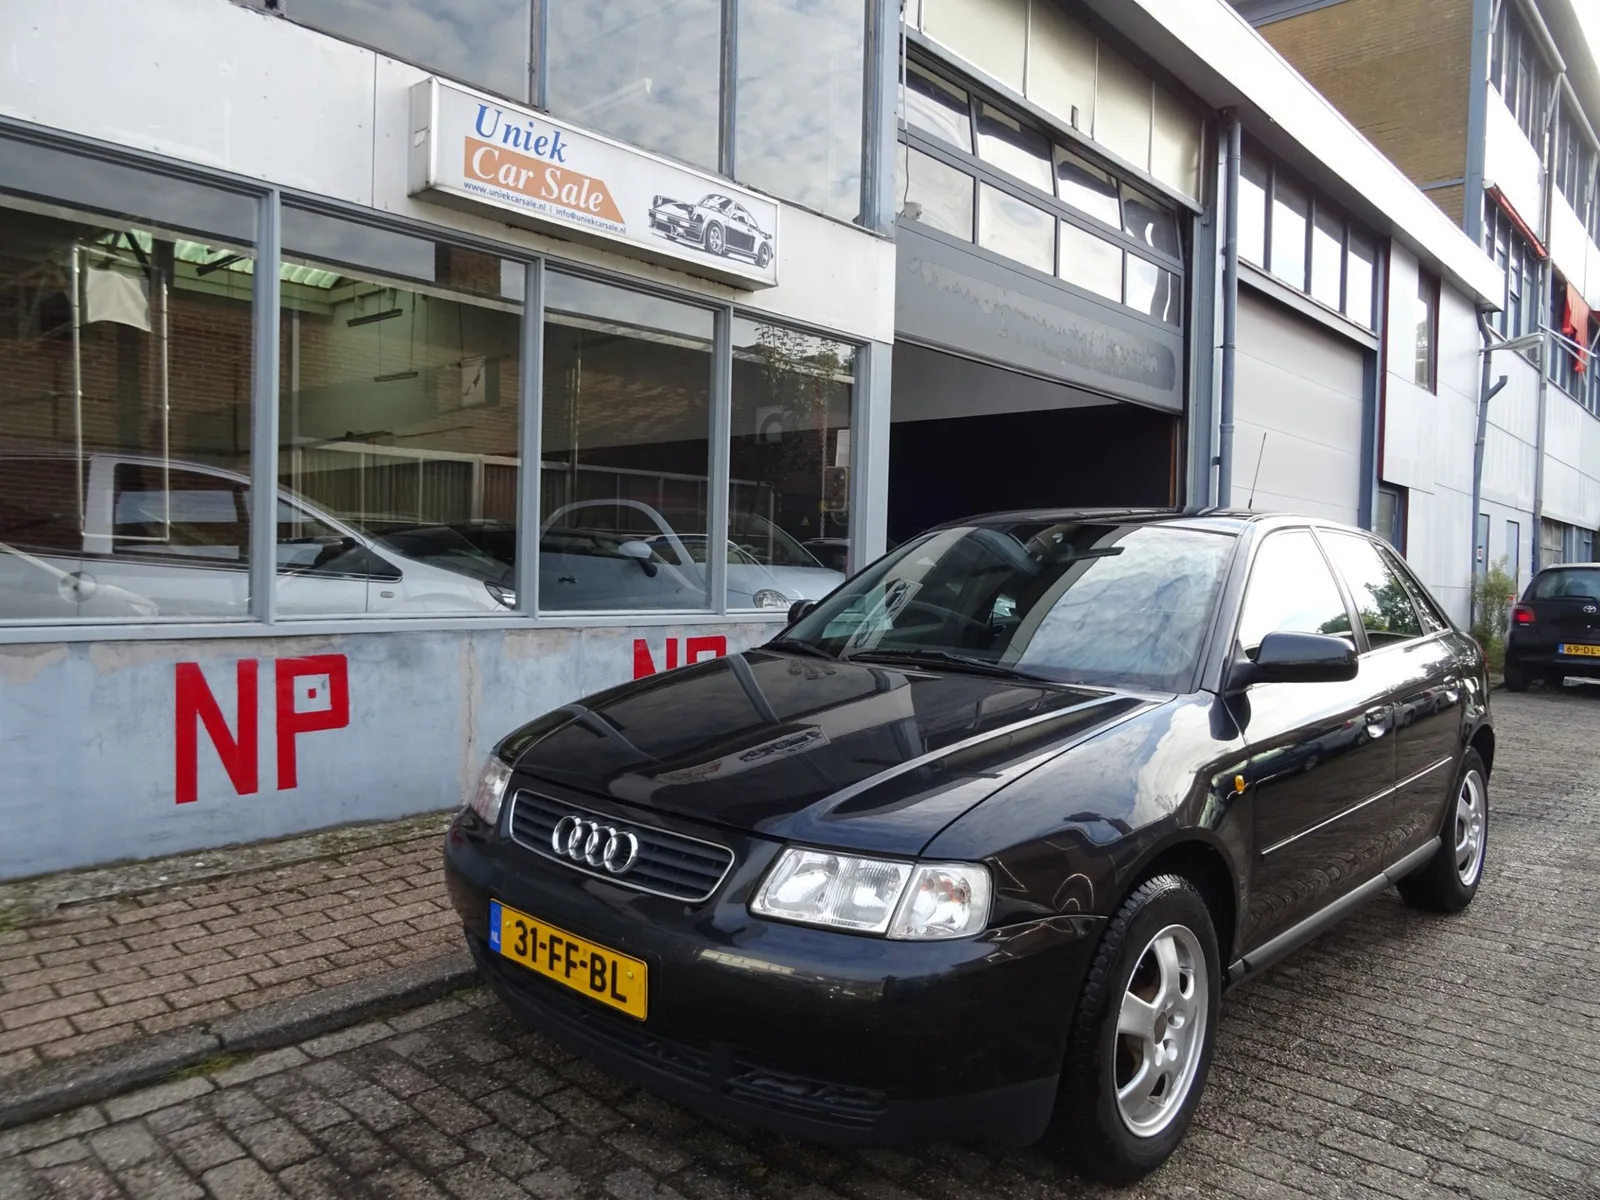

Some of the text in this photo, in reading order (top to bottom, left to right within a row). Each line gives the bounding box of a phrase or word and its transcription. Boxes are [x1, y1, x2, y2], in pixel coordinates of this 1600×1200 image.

[475, 103, 568, 163] Uniek
[464, 181, 627, 234] www.uniekcarsale.nl info@uniekcarsale.nl
[472, 147, 603, 213] Car Sale
[175, 653, 349, 805] NP
[514, 919, 627, 1004] 31-FF-BL
